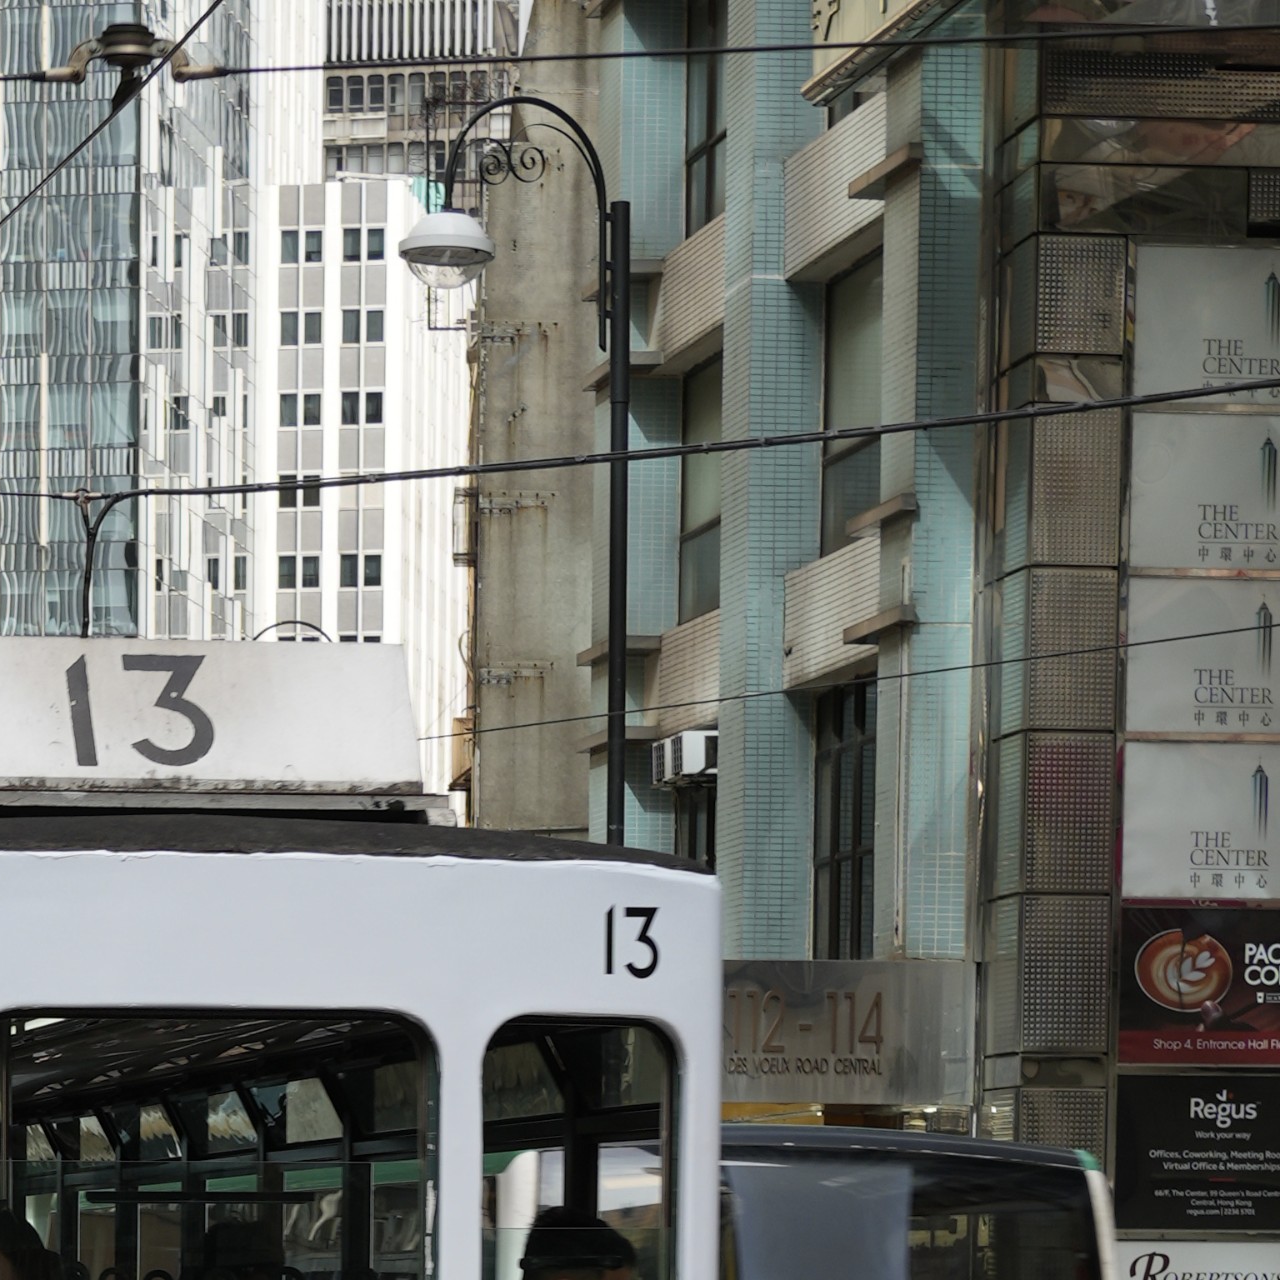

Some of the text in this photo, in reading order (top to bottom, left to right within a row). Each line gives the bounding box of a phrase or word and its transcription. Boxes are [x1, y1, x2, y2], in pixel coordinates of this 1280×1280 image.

[1202, 338, 1243, 356] THE
[1202, 356, 1280, 375] CENTER
[1198, 504, 1239, 521] THE
[1198, 522, 1279, 540] CENTER
[1198, 545, 1277, 563] 中環中心
[1194, 668, 1234, 686] THE
[1194, 686, 1274, 704] CENTER
[65, 653, 214, 767] 13
[1194, 709, 1272, 727] 中環中心
[1190, 831, 1231, 848] THE
[1190, 848, 1270, 867] CENTER
[1190, 872, 1267, 889] 中環中心
[604, 906, 660, 979] 13
[1244, 965, 1280, 986] CO
[827, 991, 884, 1055] 114
[1153, 1039, 1181, 1051] Shop
[1197, 1039, 1245, 1050] Entrance
[1248, 1039, 1268, 1050] Hall
[728, 1058, 883, 1075] DES VOEUX ROAD CENTRAL
[1190, 1097, 1257, 1128] Regus
[1195, 1131, 1216, 1139] Work
[1230, 1151, 1263, 1160] Meeting
[1163, 1162, 1190, 1170] Virtual
[1191, 1162, 1217, 1170] Office
